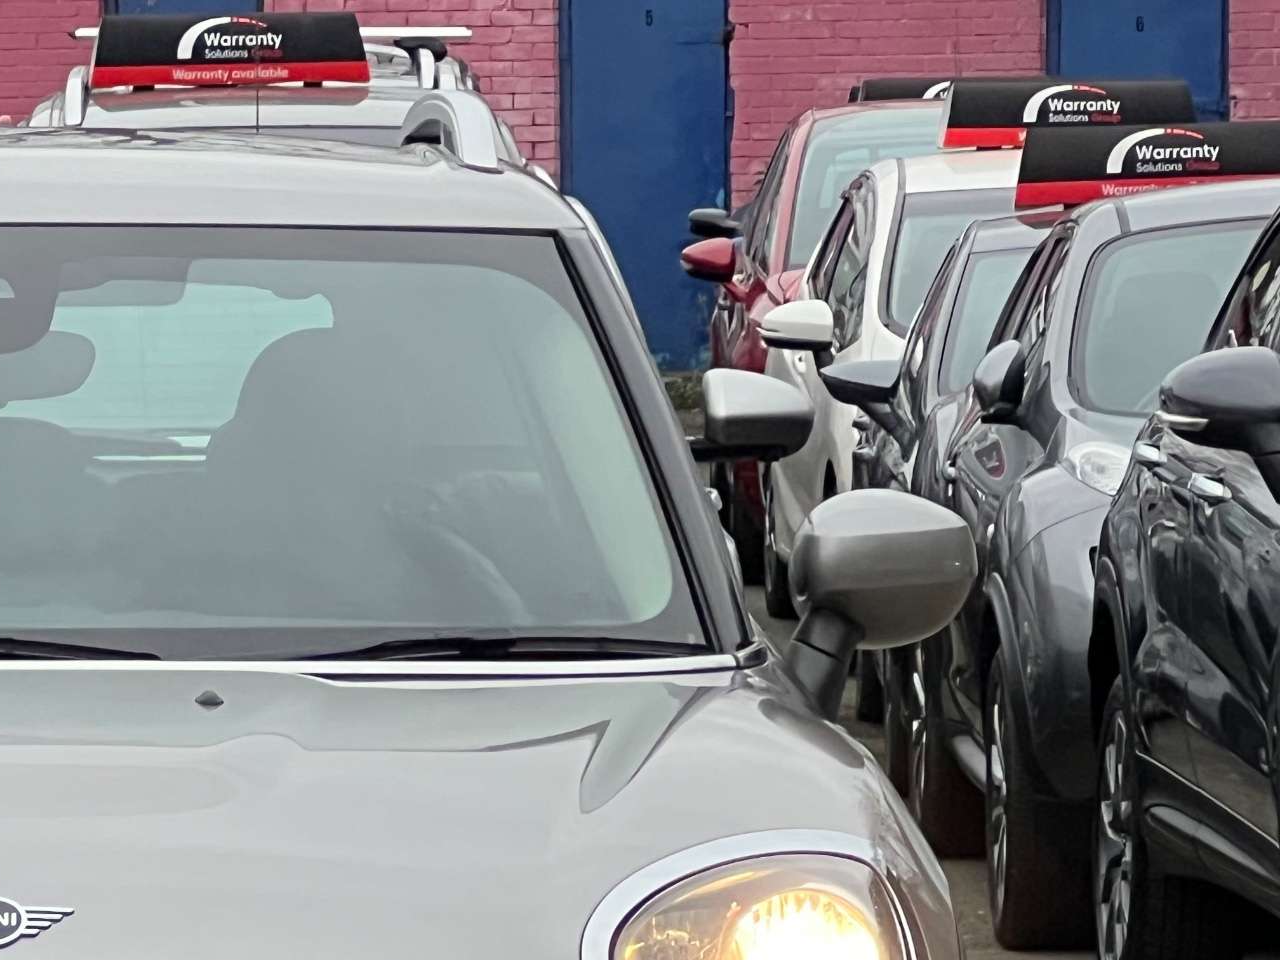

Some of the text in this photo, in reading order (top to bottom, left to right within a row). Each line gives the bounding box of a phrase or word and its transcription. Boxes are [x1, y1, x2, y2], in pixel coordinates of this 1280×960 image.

[645, 9, 654, 27] 5
[203, 32, 282, 49] Warranty
[204, 48, 248, 59] Solutions
[172, 65, 289, 82] Warranty available
[1048, 98, 1121, 114] Warranty
[1135, 143, 1220, 161] Warranty
[1136, 161, 1183, 173] Solutions
